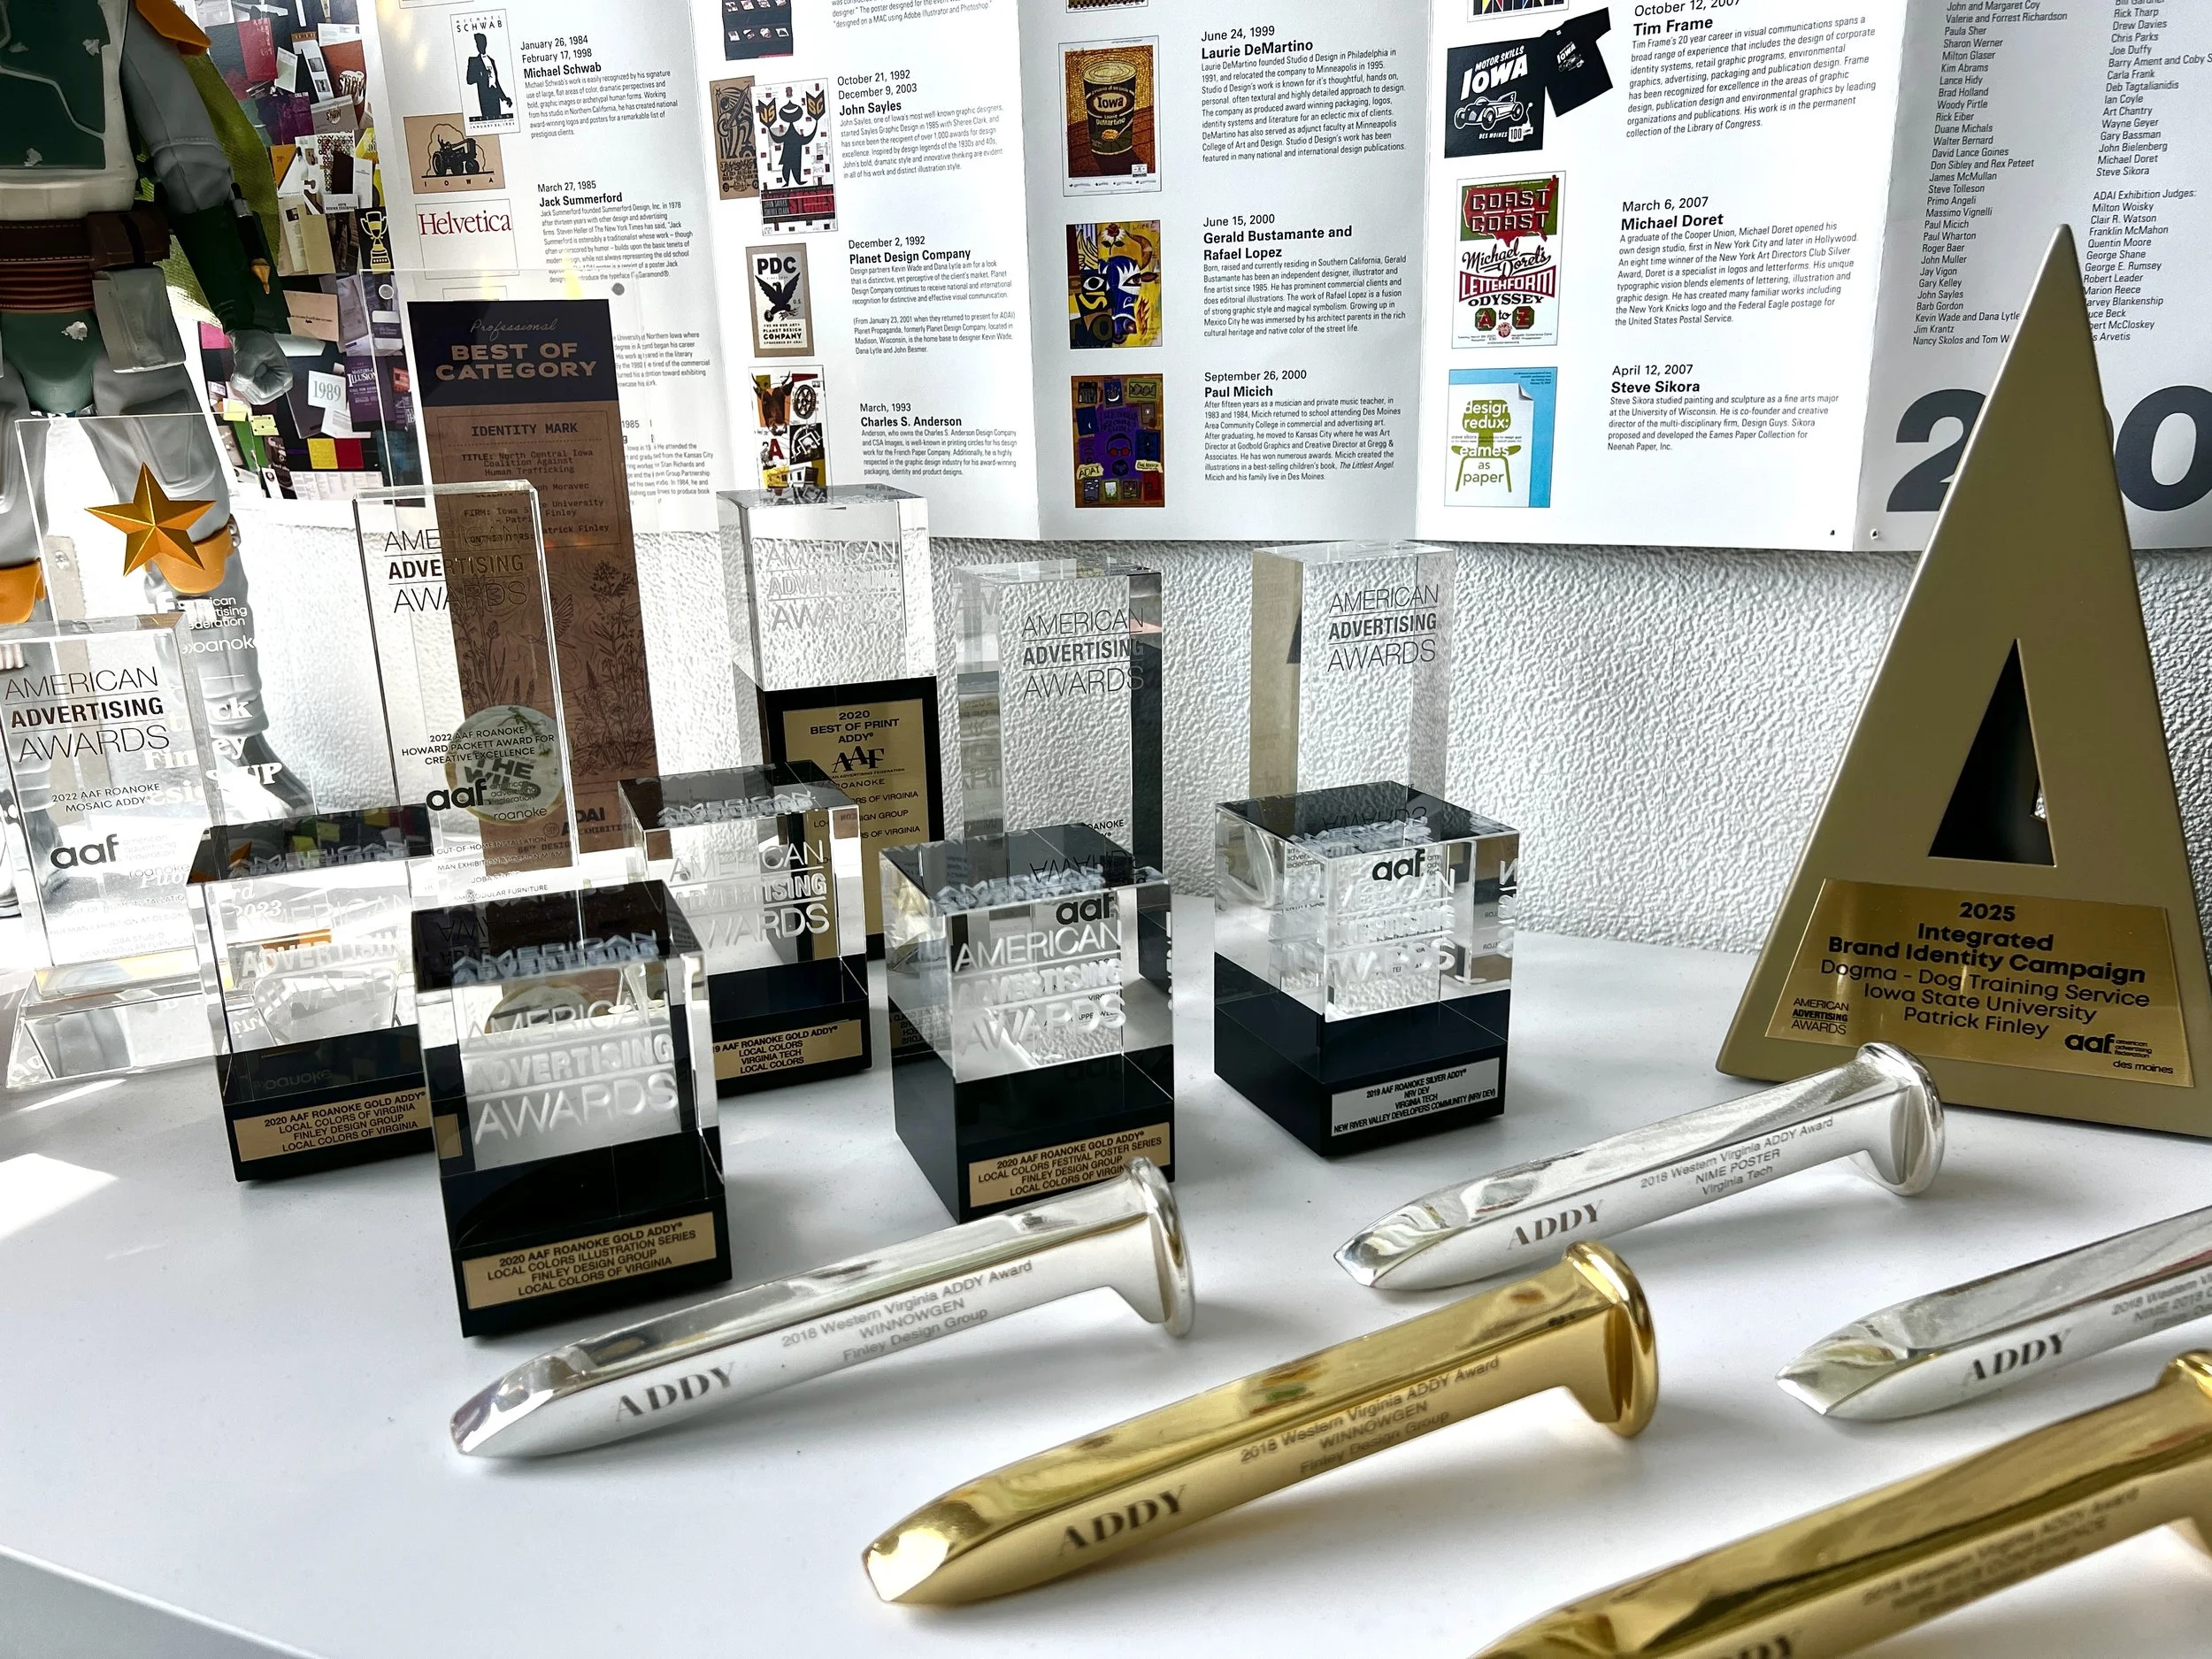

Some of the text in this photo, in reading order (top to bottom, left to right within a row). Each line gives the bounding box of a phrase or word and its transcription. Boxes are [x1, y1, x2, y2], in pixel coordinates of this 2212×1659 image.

[1201, 25, 1274, 42] June 24, 1999
[1633, 19, 1712, 35] Tim Frame
[1944, 26, 1986, 35] Paula Sher
[521, 35, 588, 50] January 26, 1984
[1202, 40, 1312, 58] Laurie DeMartino
[1943, 38, 2003, 48] Sharon Werner
[522, 48, 592, 63] February 17, 1998
[1222, 60, 1256, 69] DeMartino
[1258, 56, 1285, 65] founded
[1286, 55, 1307, 64] Studio
[1309, 53, 1313, 62] d
[1315, 53, 1338, 62] Design
[1347, 49, 1387, 58] Philadelphia
[523, 62, 601, 78] Michael Schwab
[838, 69, 910, 86] October 21, 1992
[839, 82, 917, 100] December 9, 2003
[839, 100, 901, 115] John Sayles
[2102, 106, 2152, 116] Art Chantry
[537, 180, 595, 192] March 27, 1985
[2093, 188, 2195, 200] ADAI Exhibition Judges:
[539, 192, 622, 207] Jack Summerford
[1622, 196, 1708, 211] March 6, 2007
[419, 211, 511, 234] Helvetica
[1202, 213, 1274, 227] June 15, 2000
[1621, 213, 1723, 230] Michael Doret
[848, 235, 925, 249] December 2, 1992
[1203, 225, 1351, 243] Gerald Bustamante and
[849, 250, 971, 265] Planet Design Company
[1203, 247, 1281, 260] Rafael Lopez
[757, 257, 796, 274] PDC
[452, 342, 577, 360] BEST OF
[436, 361, 596, 380] CATEGORY
[1204, 369, 1306, 382] September 26, 2000
[1611, 364, 1693, 377] April 12, 2007
[312, 380, 342, 402] 1989
[1204, 385, 1272, 397] Paul Micich
[1611, 380, 1699, 393] Steve Sikora
[859, 403, 910, 412] March, 1993
[1464, 401, 1509, 417] design
[472, 422, 577, 436] IDENTITY MARK
[860, 416, 961, 426] Charles S. Anderson
[1464, 415, 1509, 428] redux:
[1460, 445, 1509, 457] eames
[1636, 442, 1657, 450] Paper,
[1463, 473, 1504, 486] paper
[1329, 585, 1438, 612] AMERICAN
[1330, 613, 1436, 639] ADVERTISING
[1328, 640, 1435, 672] AWARDS
[5, 666, 158, 700] AMERICAN
[12, 698, 163, 726] ADVERTISING
[839, 710, 870, 720] 2020
[810, 718, 899, 734] BEST OF PRINT
[19, 726, 169, 763] AWARDS
[402, 744, 449, 756] HOWARD
[451, 741, 494, 751] PACKETT
[496, 736, 533, 747] AWARD
[52, 784, 160, 803] 2022 AAF ROANOKE
[1960, 902, 2015, 921] 2025
[1918, 923, 2053, 951] Integrated
[1828, 936, 2145, 985] Brand Identity Campaign
[1822, 959, 1896, 984] Dogma
[1919, 969, 1962, 990] Dog
[1970, 974, 2058, 1000] Training
[2066, 985, 2149, 1007] Service
[1864, 983, 2097, 1024] Iowa State University
[1905, 1007, 2048, 1039] Patrick Finley
[2065, 1033, 2116, 1054] aaf
[2112, 1060, 2173, 1073] des moines
[1507, 1199, 1603, 1250] ADDY
[488, 1230, 695, 1280] LOCAL COLORS ILLUSTRATION SERIES
[499, 1255, 525, 1265] 2020
[527, 1248, 549, 1261] AAF
[553, 1238, 610, 1255] ROANOKE
[612, 1230, 644, 1244] GOLD
[782, 1260, 1032, 1347] 2018 Western Virginia ADDY Award
[616, 1362, 735, 1422] ADDY
[1057, 1484, 1186, 1557] ADDY
